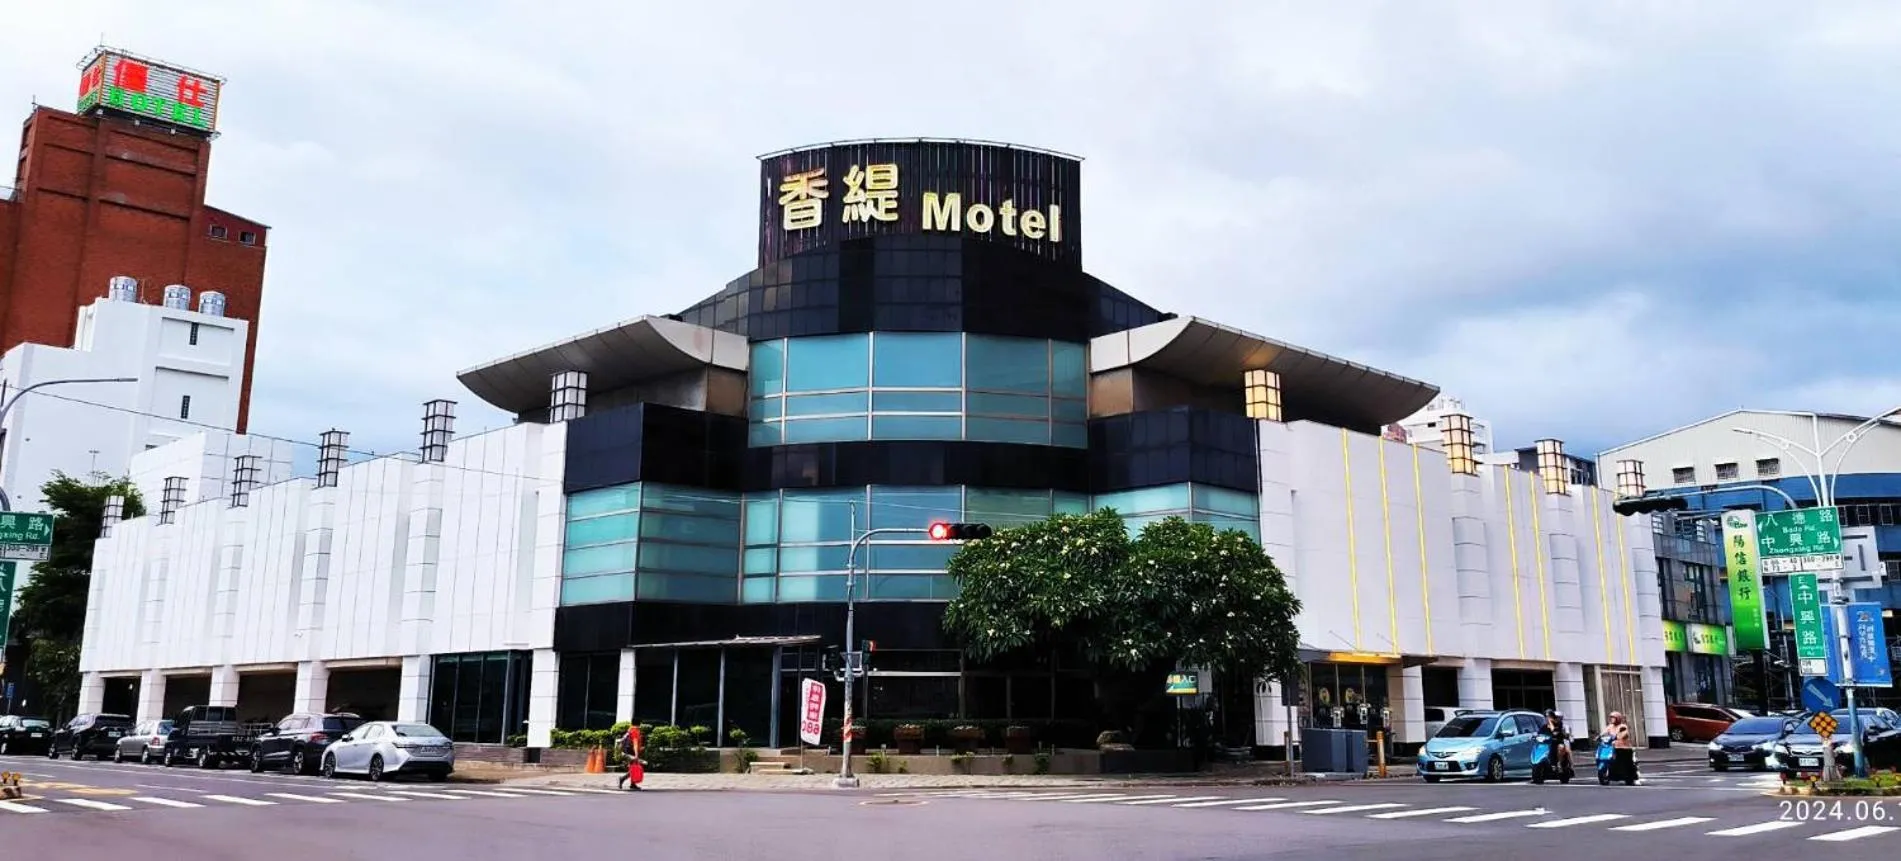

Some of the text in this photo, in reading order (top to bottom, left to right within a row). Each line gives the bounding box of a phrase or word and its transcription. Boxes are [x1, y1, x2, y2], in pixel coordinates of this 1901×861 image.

[779, 164, 1061, 242] 香緹 Motel
[1761, 531, 1830, 548] 中興路
[1766, 510, 1832, 526] 八德路
[1733, 534, 1751, 600] 陽信銀行
[1797, 590, 1817, 645] 中興路
